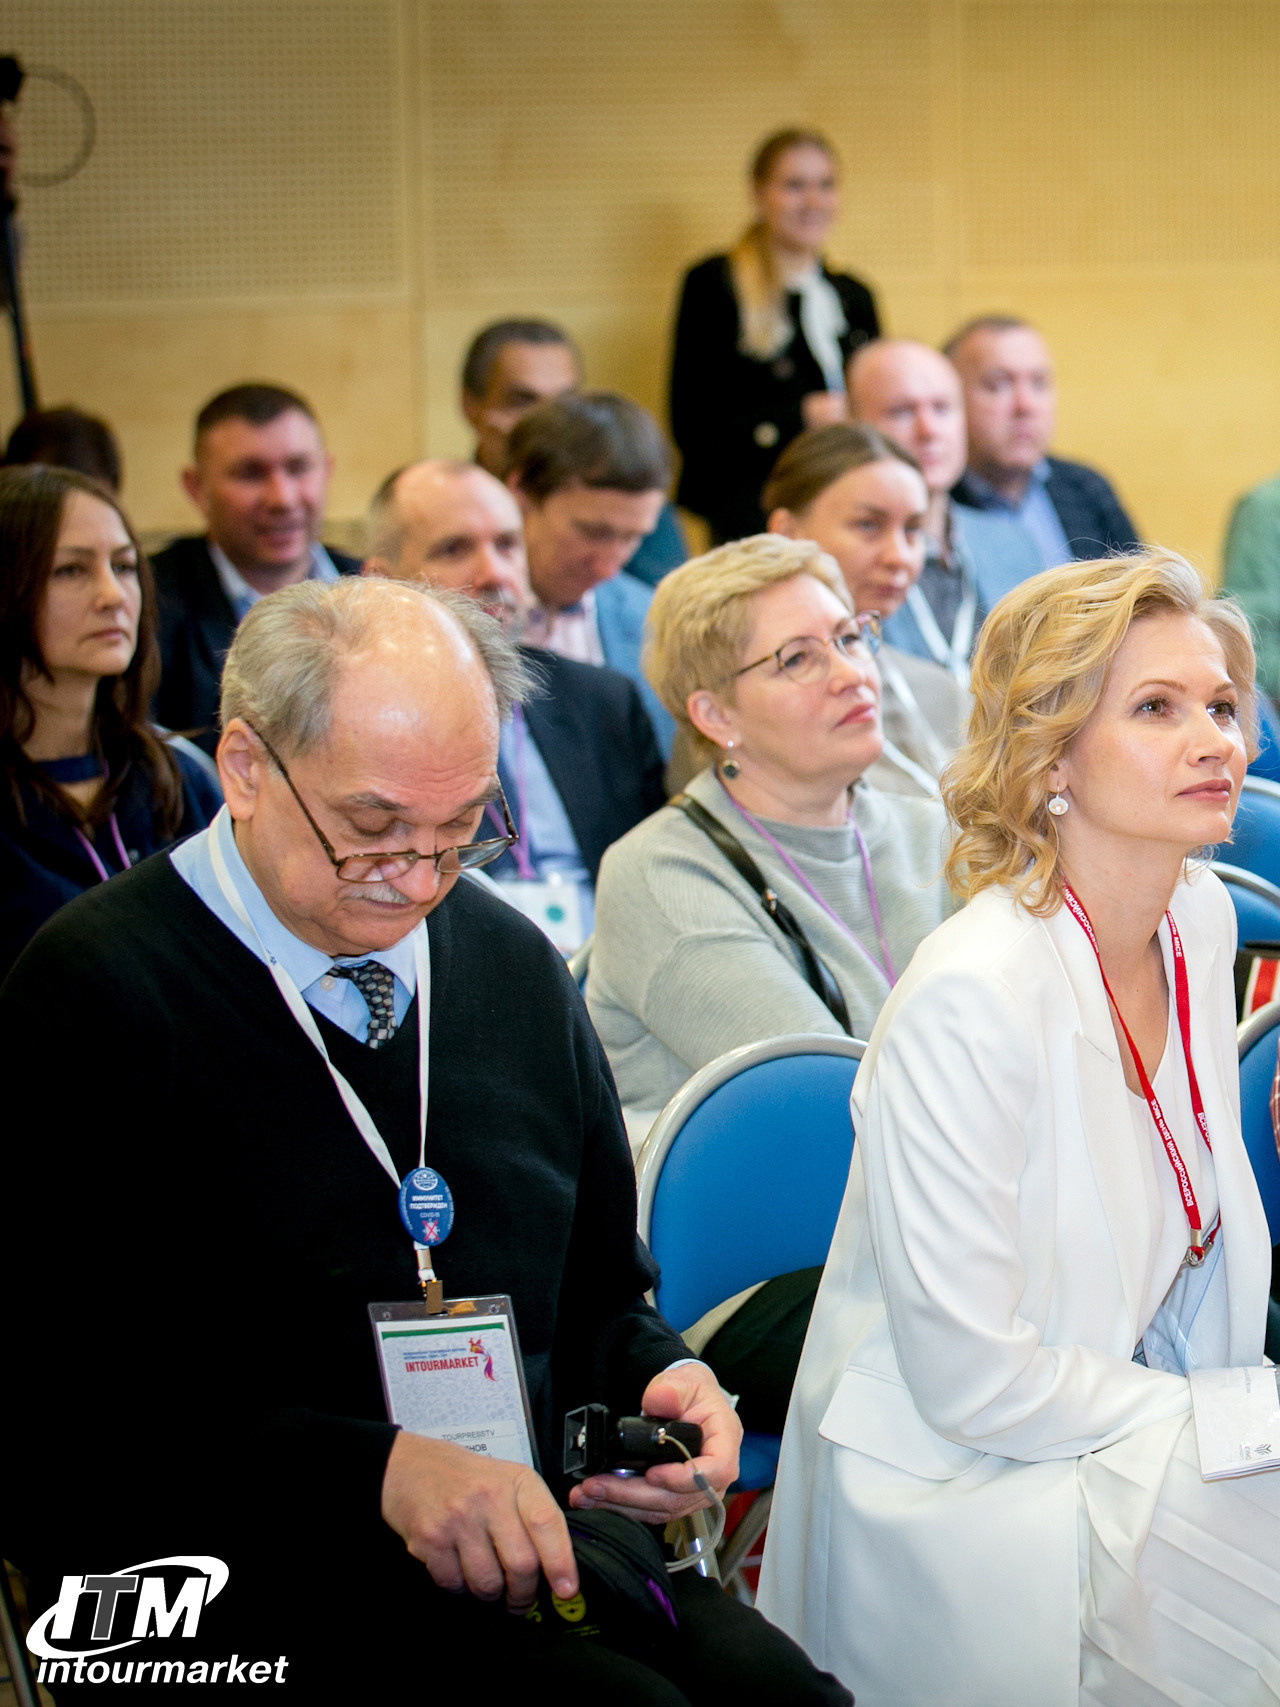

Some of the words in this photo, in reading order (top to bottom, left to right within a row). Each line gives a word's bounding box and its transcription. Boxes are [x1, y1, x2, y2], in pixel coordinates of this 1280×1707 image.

[1174, 936, 1183, 958] MICE
[1150, 1098, 1162, 1120] MICE
[1158, 1119, 1172, 1141] ДЕНЬ
[1166, 1140, 1195, 1207] ВСЕРОССИЙСКИЙ
[405, 1356, 479, 1373] INTOURMARKET
[441, 1429, 495, 1441] TOURPRESSTV
